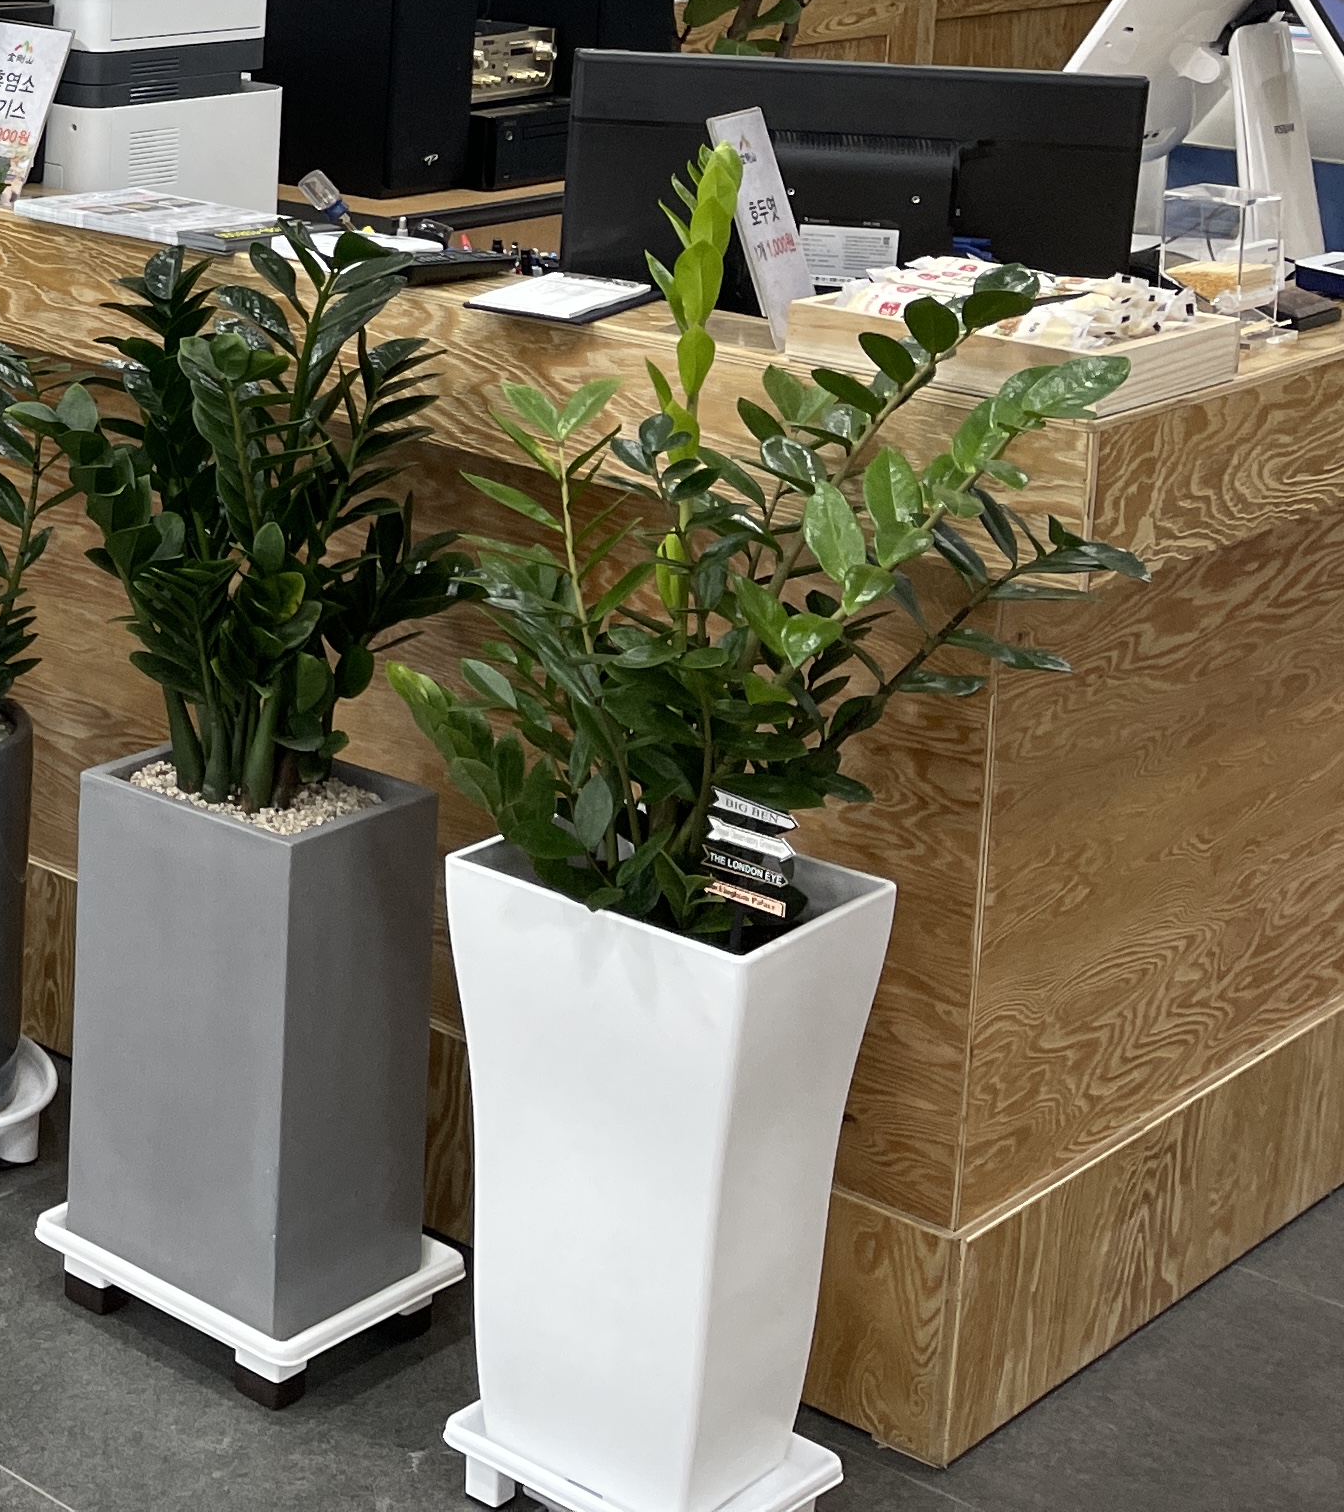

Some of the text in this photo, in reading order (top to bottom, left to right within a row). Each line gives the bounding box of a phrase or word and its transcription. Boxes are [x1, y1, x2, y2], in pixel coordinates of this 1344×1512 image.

[748, 194, 780, 226] 호두엿
[753, 242, 768, 262] 1개
[767, 231, 797, 259] 1,000원
[724, 797, 780, 824] BIG BEN
[709, 851, 783, 885] THE LONDON EYE
